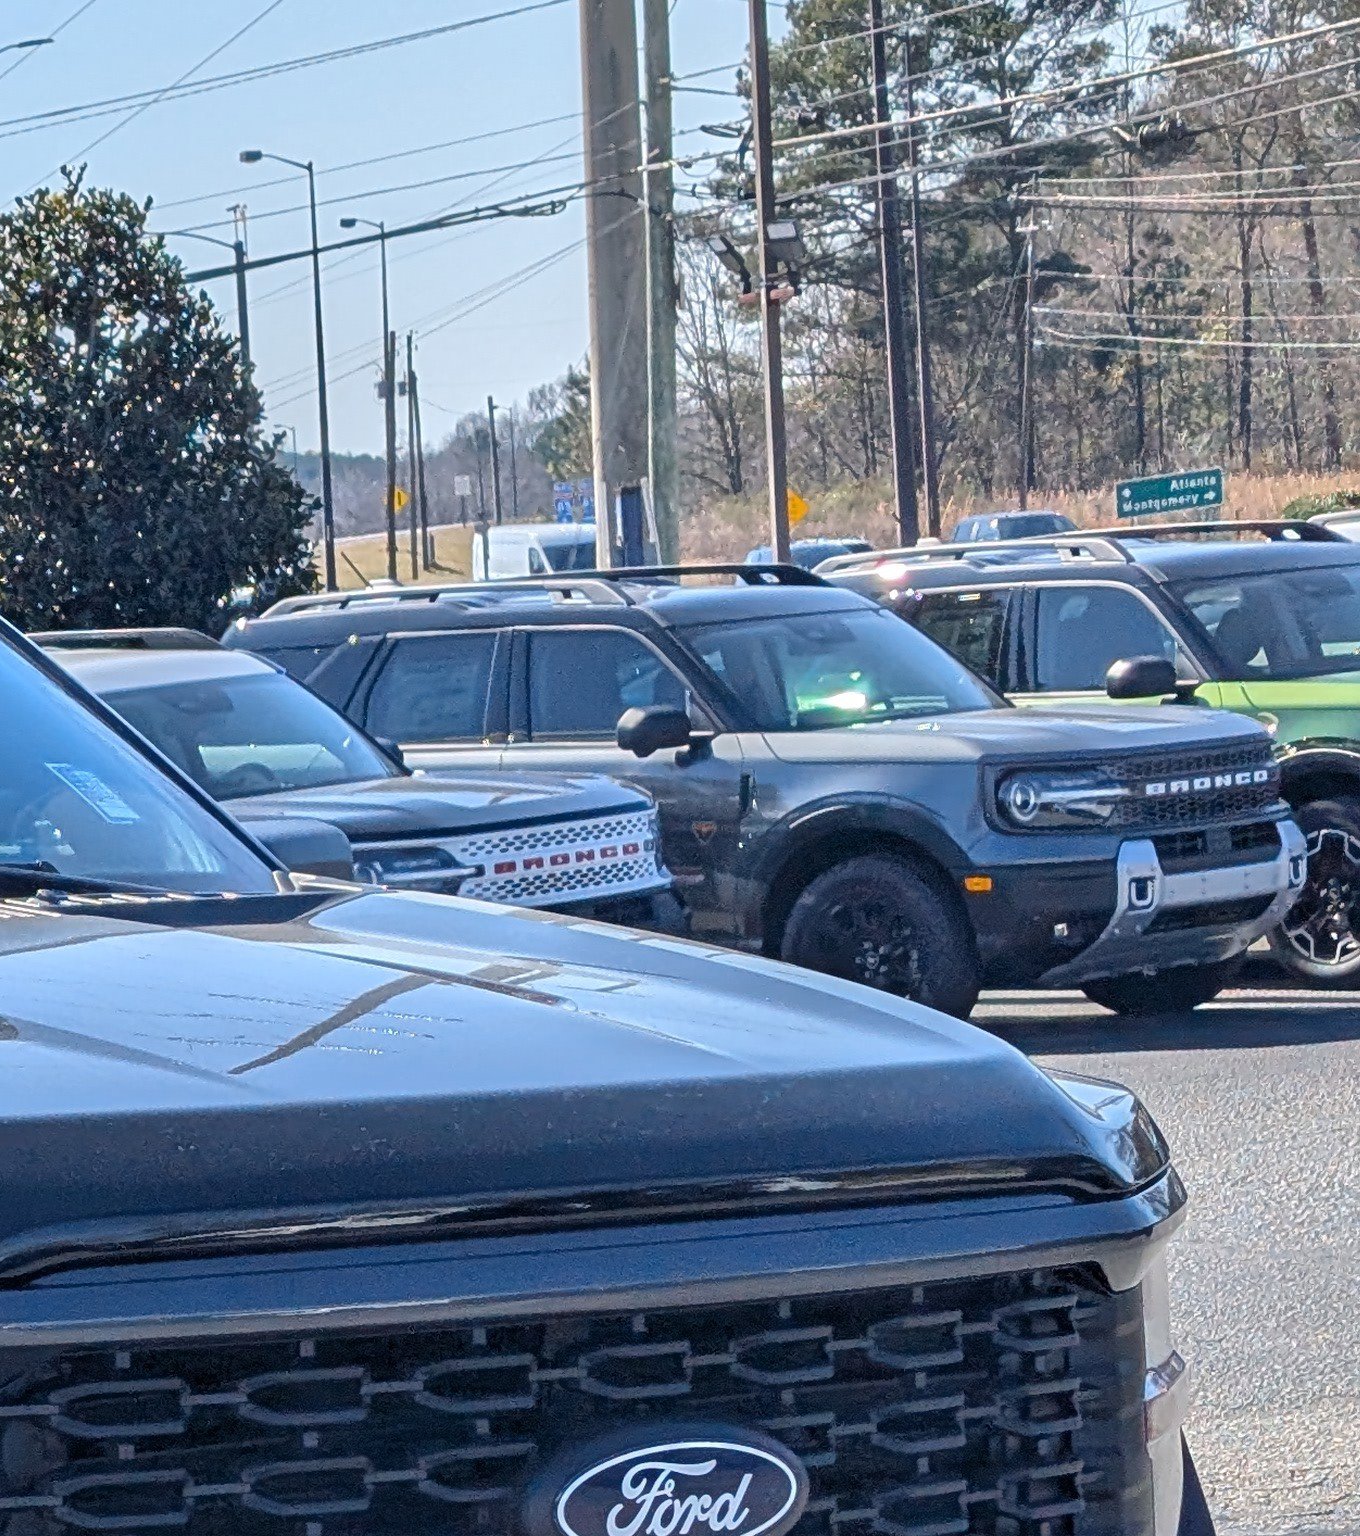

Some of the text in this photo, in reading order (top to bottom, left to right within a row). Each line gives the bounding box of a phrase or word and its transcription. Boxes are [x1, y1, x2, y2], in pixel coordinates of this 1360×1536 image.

[1170, 476, 1217, 492] Atlanta
[1145, 770, 1268, 795] BRONCO
[493, 842, 641, 875] BRONCO
